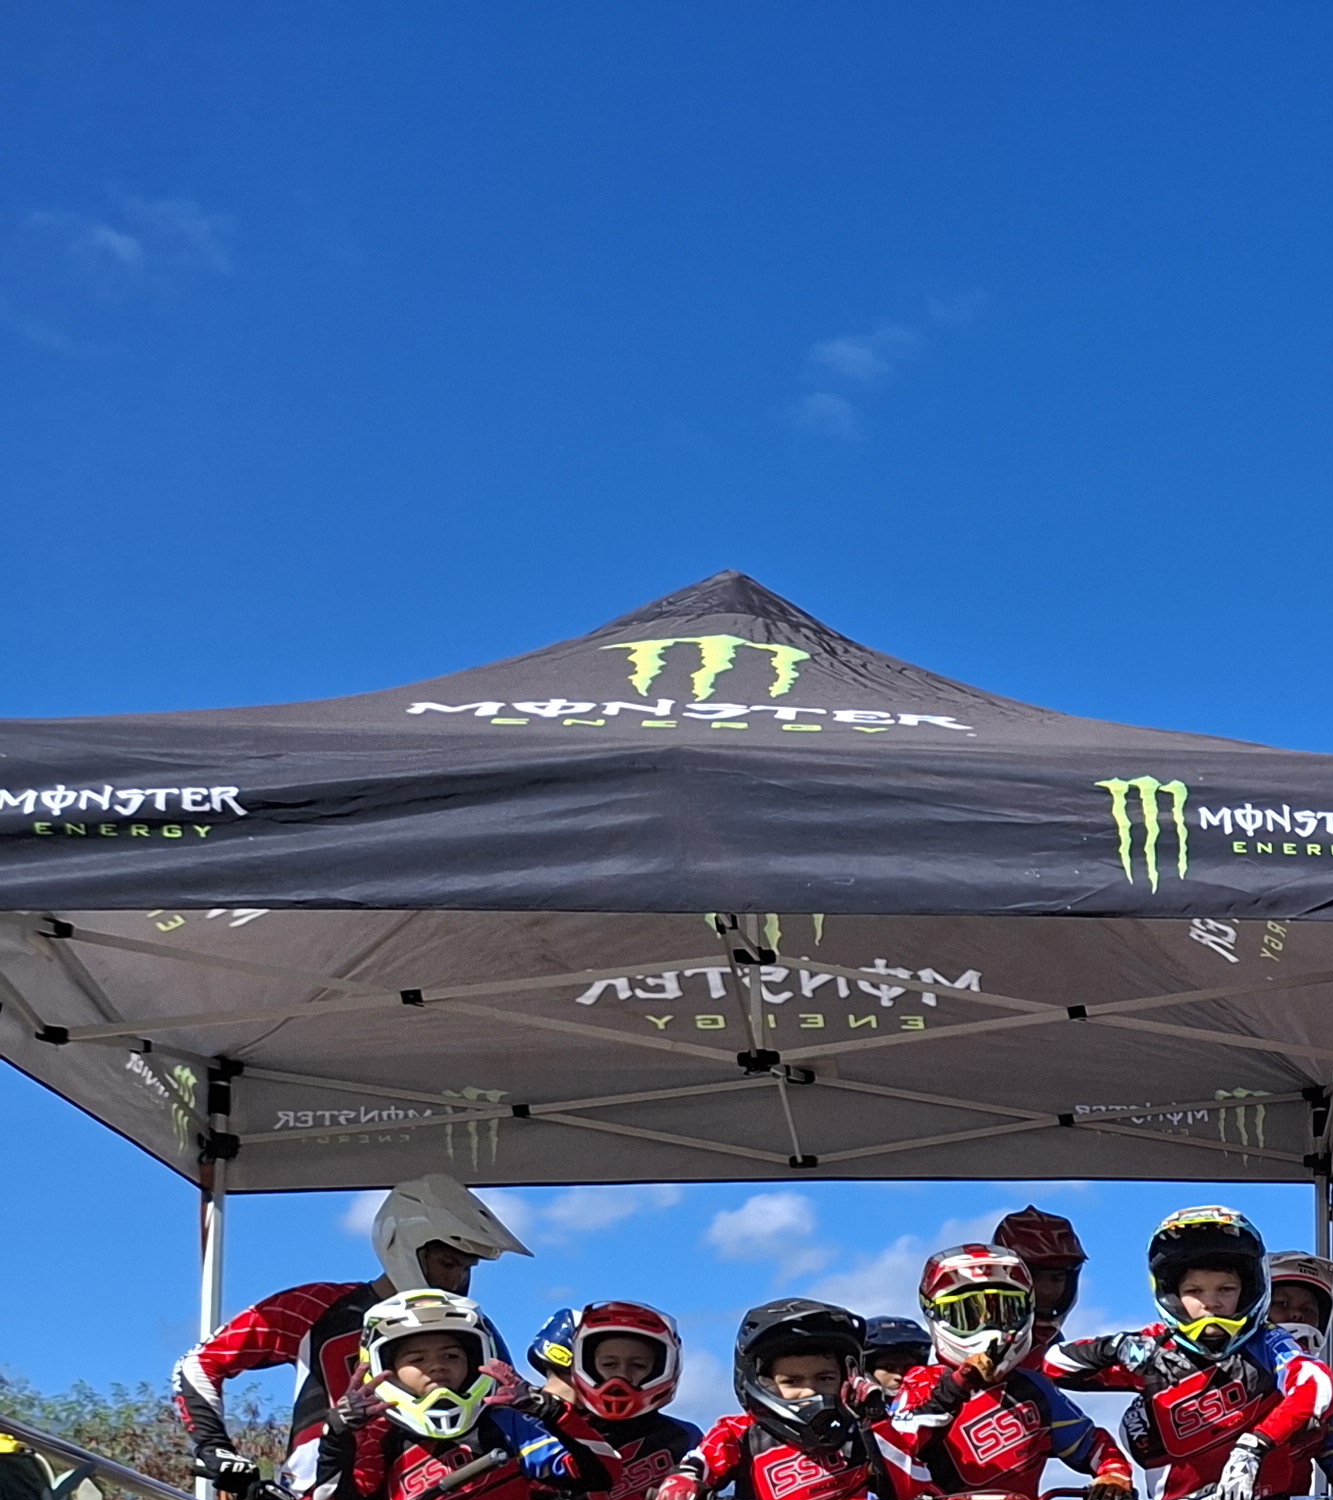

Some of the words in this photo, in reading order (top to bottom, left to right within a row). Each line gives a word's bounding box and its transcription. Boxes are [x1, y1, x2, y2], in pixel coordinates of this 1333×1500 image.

[406, 699, 974, 730] MONSTER
[0, 785, 248, 816] MONSTER
[33, 822, 212, 838] ENERGY
[220, 1461, 258, 1475] FOX
